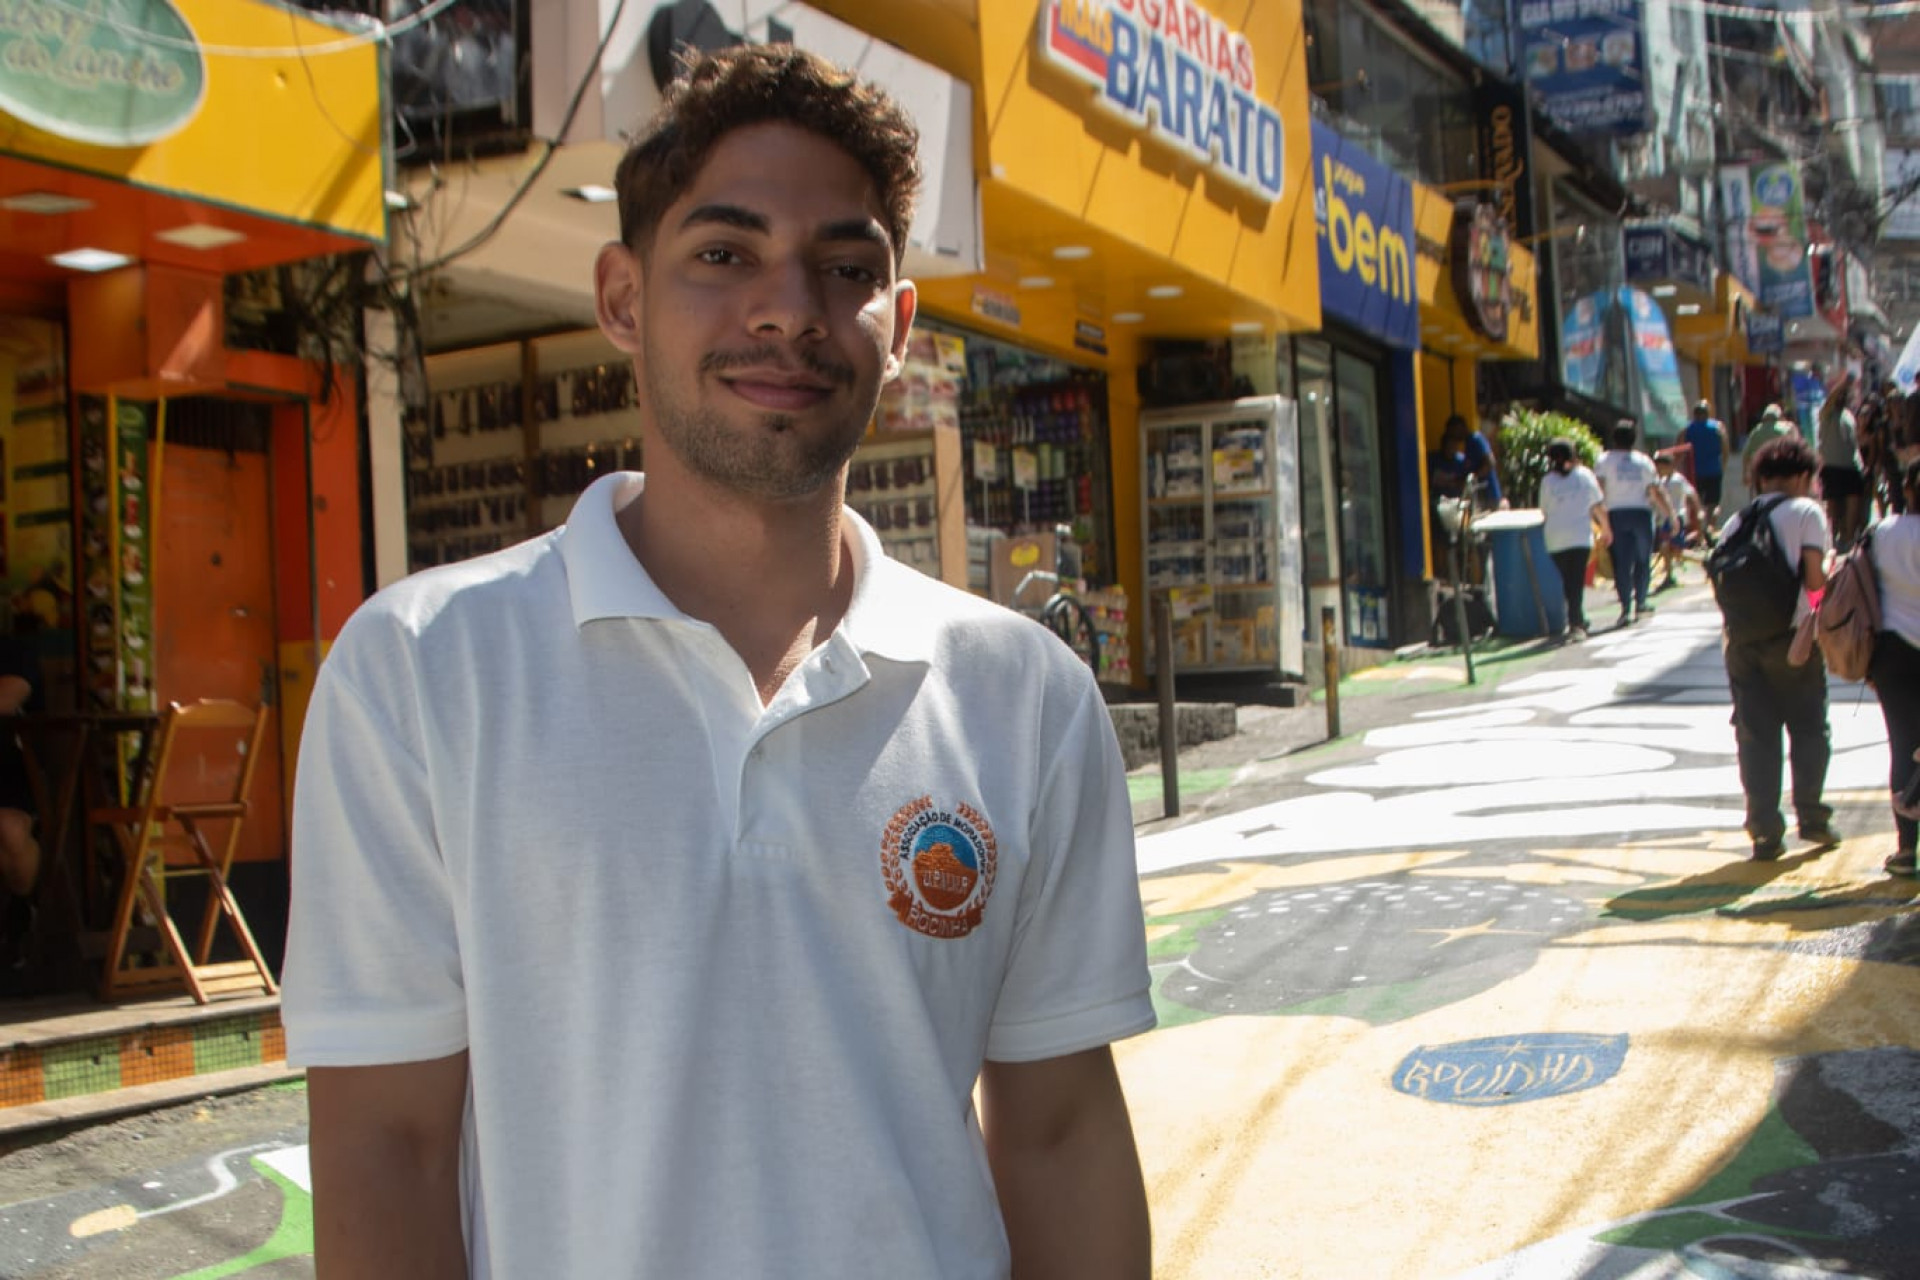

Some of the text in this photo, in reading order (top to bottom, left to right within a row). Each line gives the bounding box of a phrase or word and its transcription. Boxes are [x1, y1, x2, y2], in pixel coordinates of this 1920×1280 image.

[1106, 11, 1282, 195] BARATO
[1119, 0, 1253, 92] GARIAS
[1324, 153, 1411, 306] bem
[939, 812, 952, 824] DE
